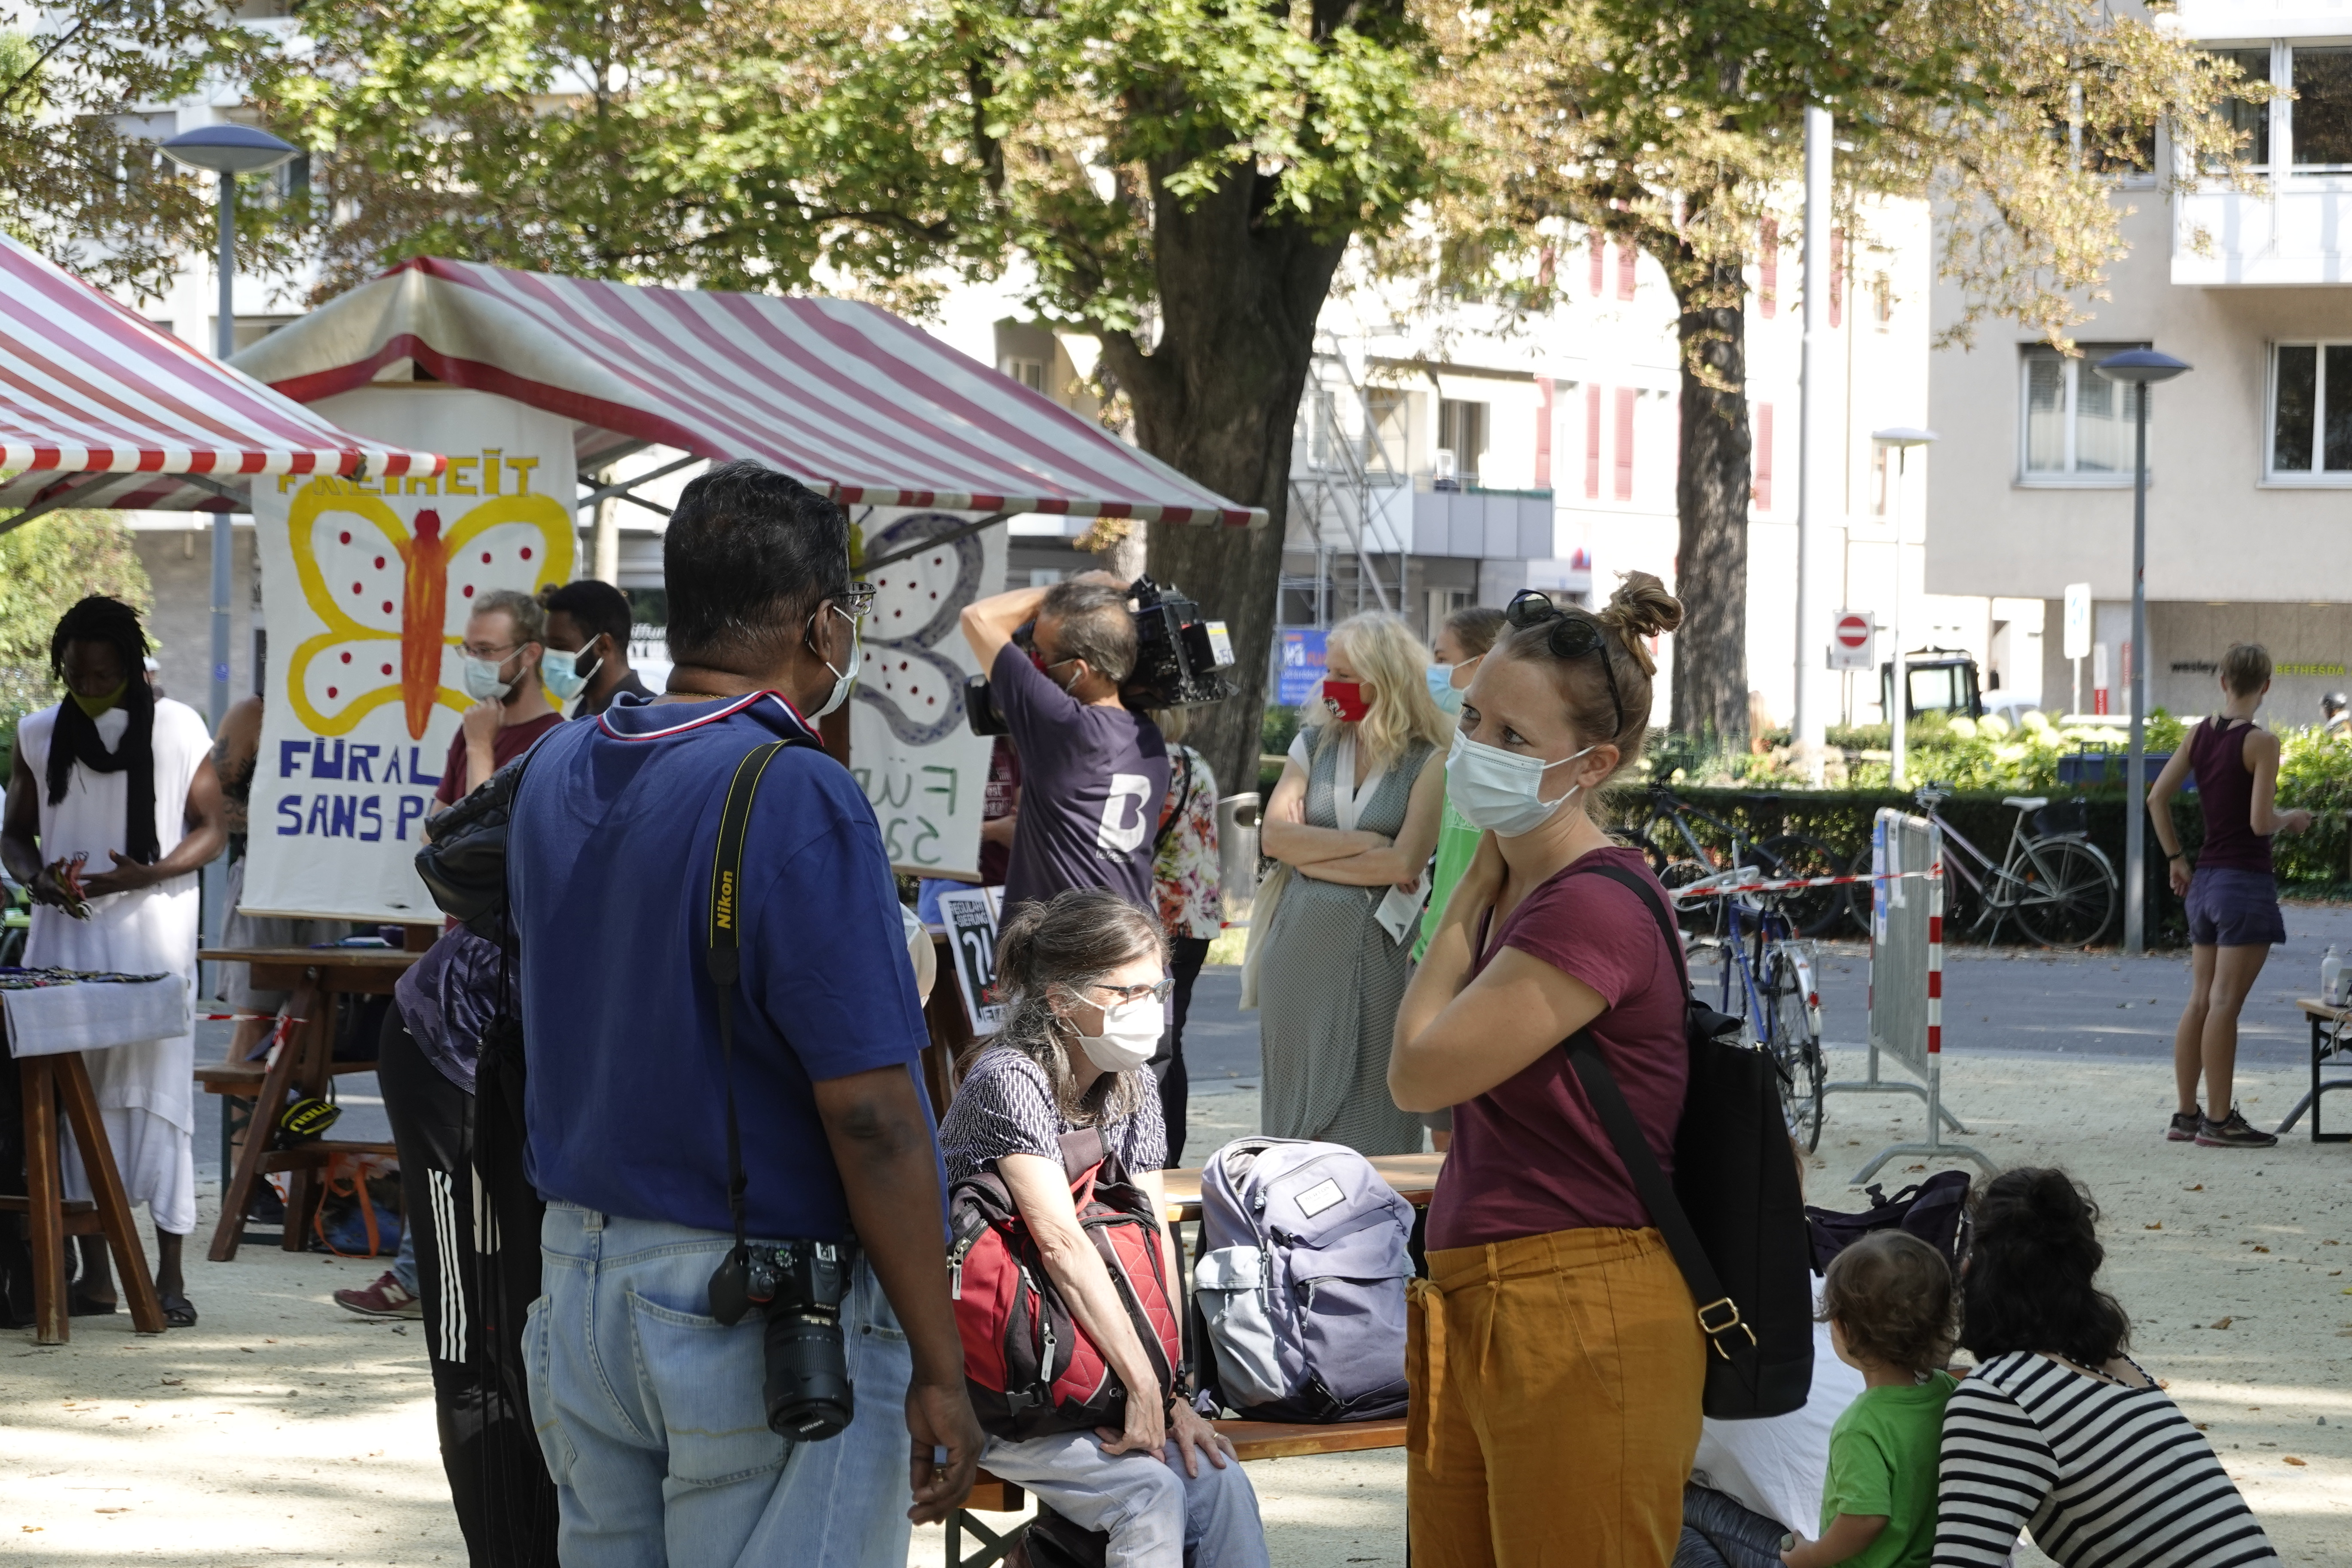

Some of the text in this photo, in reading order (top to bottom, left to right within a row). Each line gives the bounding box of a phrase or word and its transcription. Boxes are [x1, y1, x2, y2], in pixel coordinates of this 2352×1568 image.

[2275, 662, 2346, 676] BETHESDA
[279, 736, 450, 787] FÜR AL
[277, 794, 435, 842] SANS-P
[1097, 773, 1152, 853] B
[717, 870, 733, 929] Nikon
[813, 1302, 836, 1311] Nikon
[799, 1419, 824, 1433] Nikon
